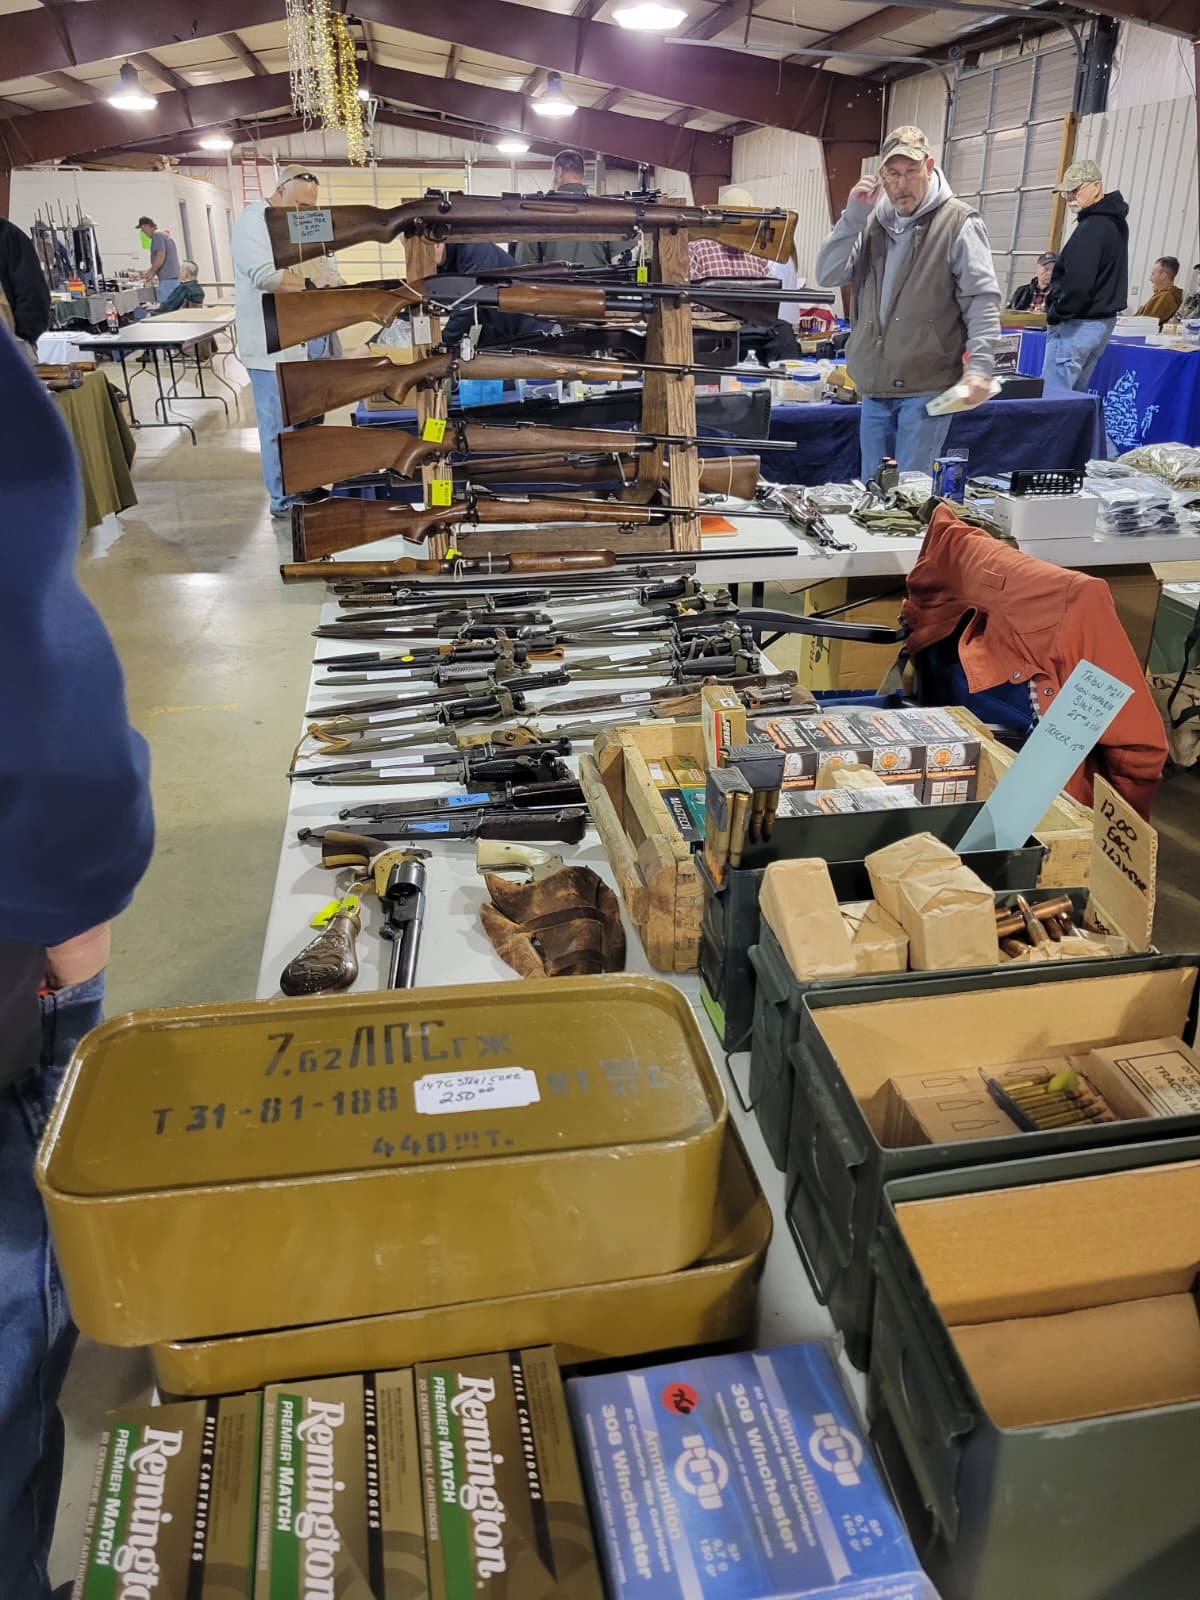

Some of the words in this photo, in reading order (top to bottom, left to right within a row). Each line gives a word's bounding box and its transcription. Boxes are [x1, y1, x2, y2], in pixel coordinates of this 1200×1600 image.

[1155, 1065, 1192, 1101] TRACER
[365, 1389, 375, 1426] RIFLE
[433, 1376, 449, 1436] PREMIER
[512, 1364, 525, 1401] RIFLE
[203, 1416, 215, 1455] RIFLE
[280, 1400, 293, 1461] PREMIER
[420, 1391, 431, 1444] CENTERFIRE
[108, 1428, 130, 1492] PREMIER
[366, 1434, 380, 1528] CARTRIDGES
[424, 1447, 433, 1473] RIFLE
[438, 1441, 456, 1504] MATCH
[451, 1373, 506, 1578] Remington
[518, 1408, 541, 1500] CARTRIDGES
[644, 1430, 682, 1540] Ammunition
[731, 1383, 754, 1423] 308
[747, 1427, 797, 1554] Winchester
[760, 1402, 782, 1454] Centerfire
[780, 1456, 792, 1481] Rifle
[789, 1483, 816, 1547] Cartridges
[774, 1407, 823, 1515] Ammunition
[192, 1463, 211, 1561] CARTRIDGES
[277, 1467, 294, 1532] MATCH
[294, 1397, 345, 1600] Remington
[427, 1476, 439, 1541] CARTRIDGES
[602, 1404, 622, 1445] 308
[613, 1450, 652, 1580] Winchester
[629, 1424, 647, 1477] Centerfire
[643, 1479, 654, 1505] Rifle
[649, 1508, 671, 1573] Cartridges
[96, 1499, 121, 1565] MATCH
